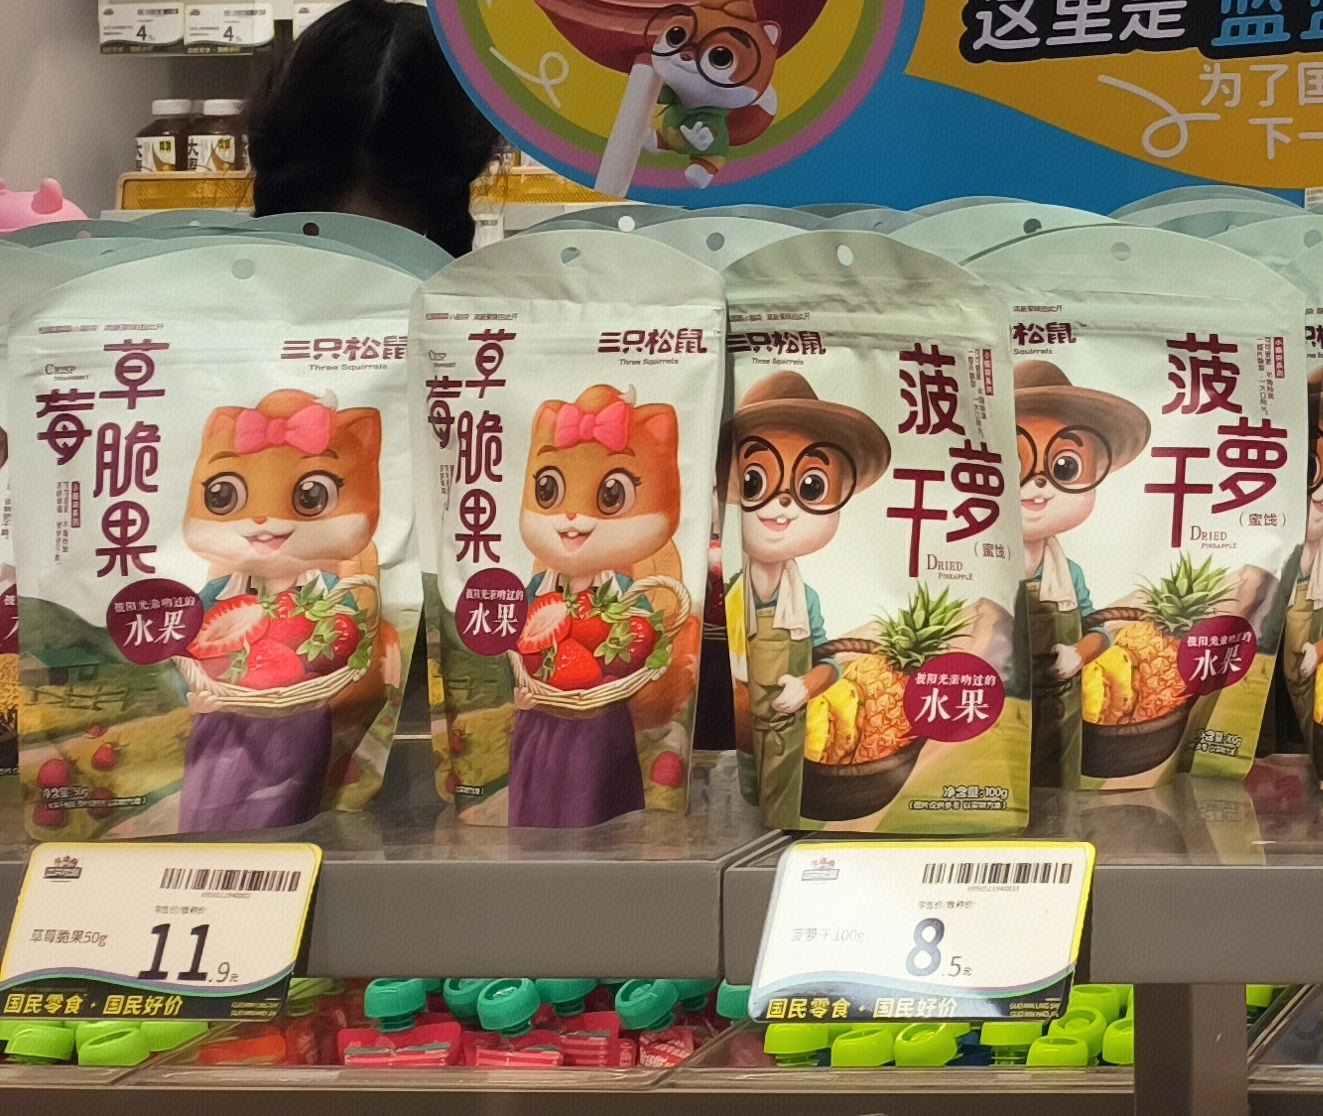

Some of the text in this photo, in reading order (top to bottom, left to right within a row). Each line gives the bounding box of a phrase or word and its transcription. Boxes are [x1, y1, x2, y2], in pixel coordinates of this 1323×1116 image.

[597, 327, 708, 356] 三只松鼠
[726, 330, 827, 356] 三只松鼠
[122, 609, 187, 647] 水果
[462, 602, 519, 639] 水果
[914, 687, 991, 725] 水果
